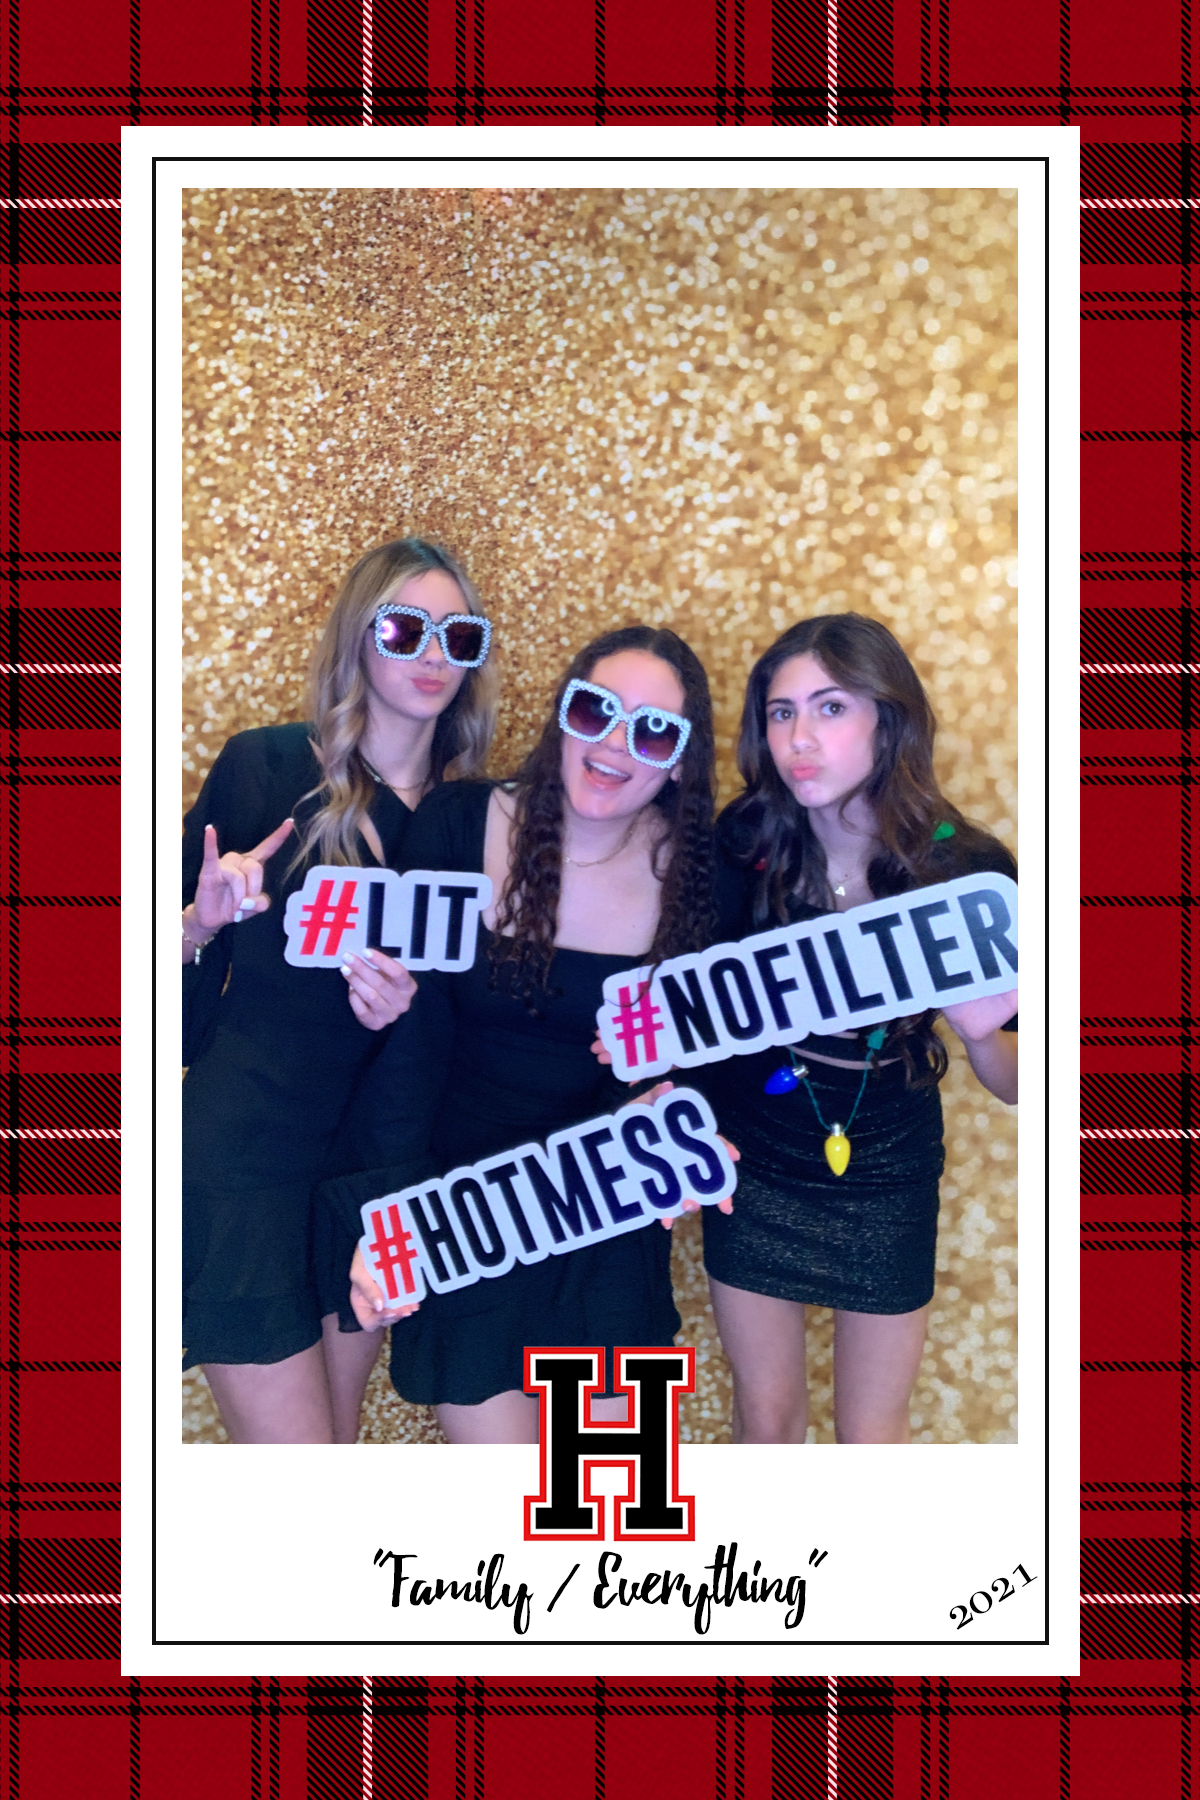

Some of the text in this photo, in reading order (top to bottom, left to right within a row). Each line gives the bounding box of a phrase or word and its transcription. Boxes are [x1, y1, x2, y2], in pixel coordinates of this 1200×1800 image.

[299, 879, 478, 961] #LIT
[612, 889, 1018, 1068] #NOFILTER
[369, 1099, 726, 1300] #HOTMESS
